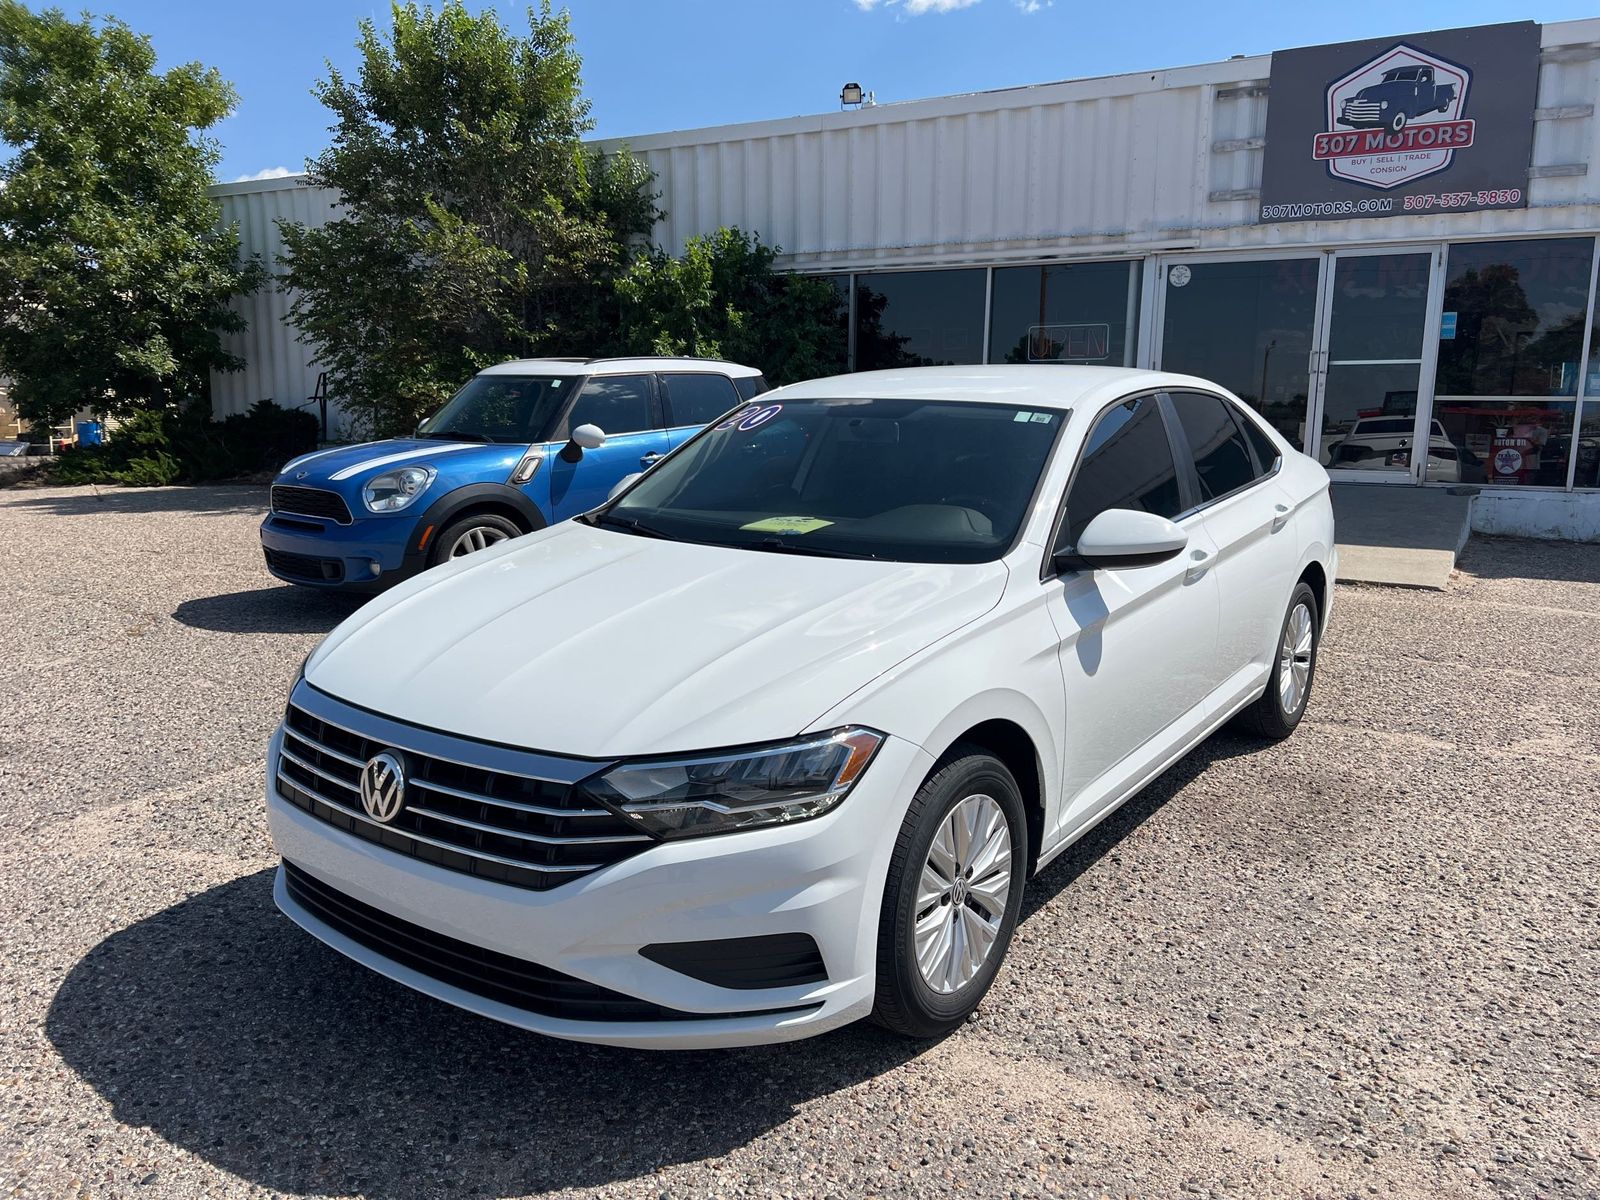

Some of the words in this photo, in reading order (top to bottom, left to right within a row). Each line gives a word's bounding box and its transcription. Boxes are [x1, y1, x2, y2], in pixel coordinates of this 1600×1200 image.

[1318, 135, 1358, 155] 307
[1365, 124, 1469, 151] MOTORS
[1404, 152, 1431, 161] TRADE
[1369, 165, 1407, 174] CONSIGN
[1262, 198, 1393, 219] 307MOTORS.COM
[1403, 189, 1521, 210] 307-337-3830
[1031, 327, 1105, 358] OPEN
